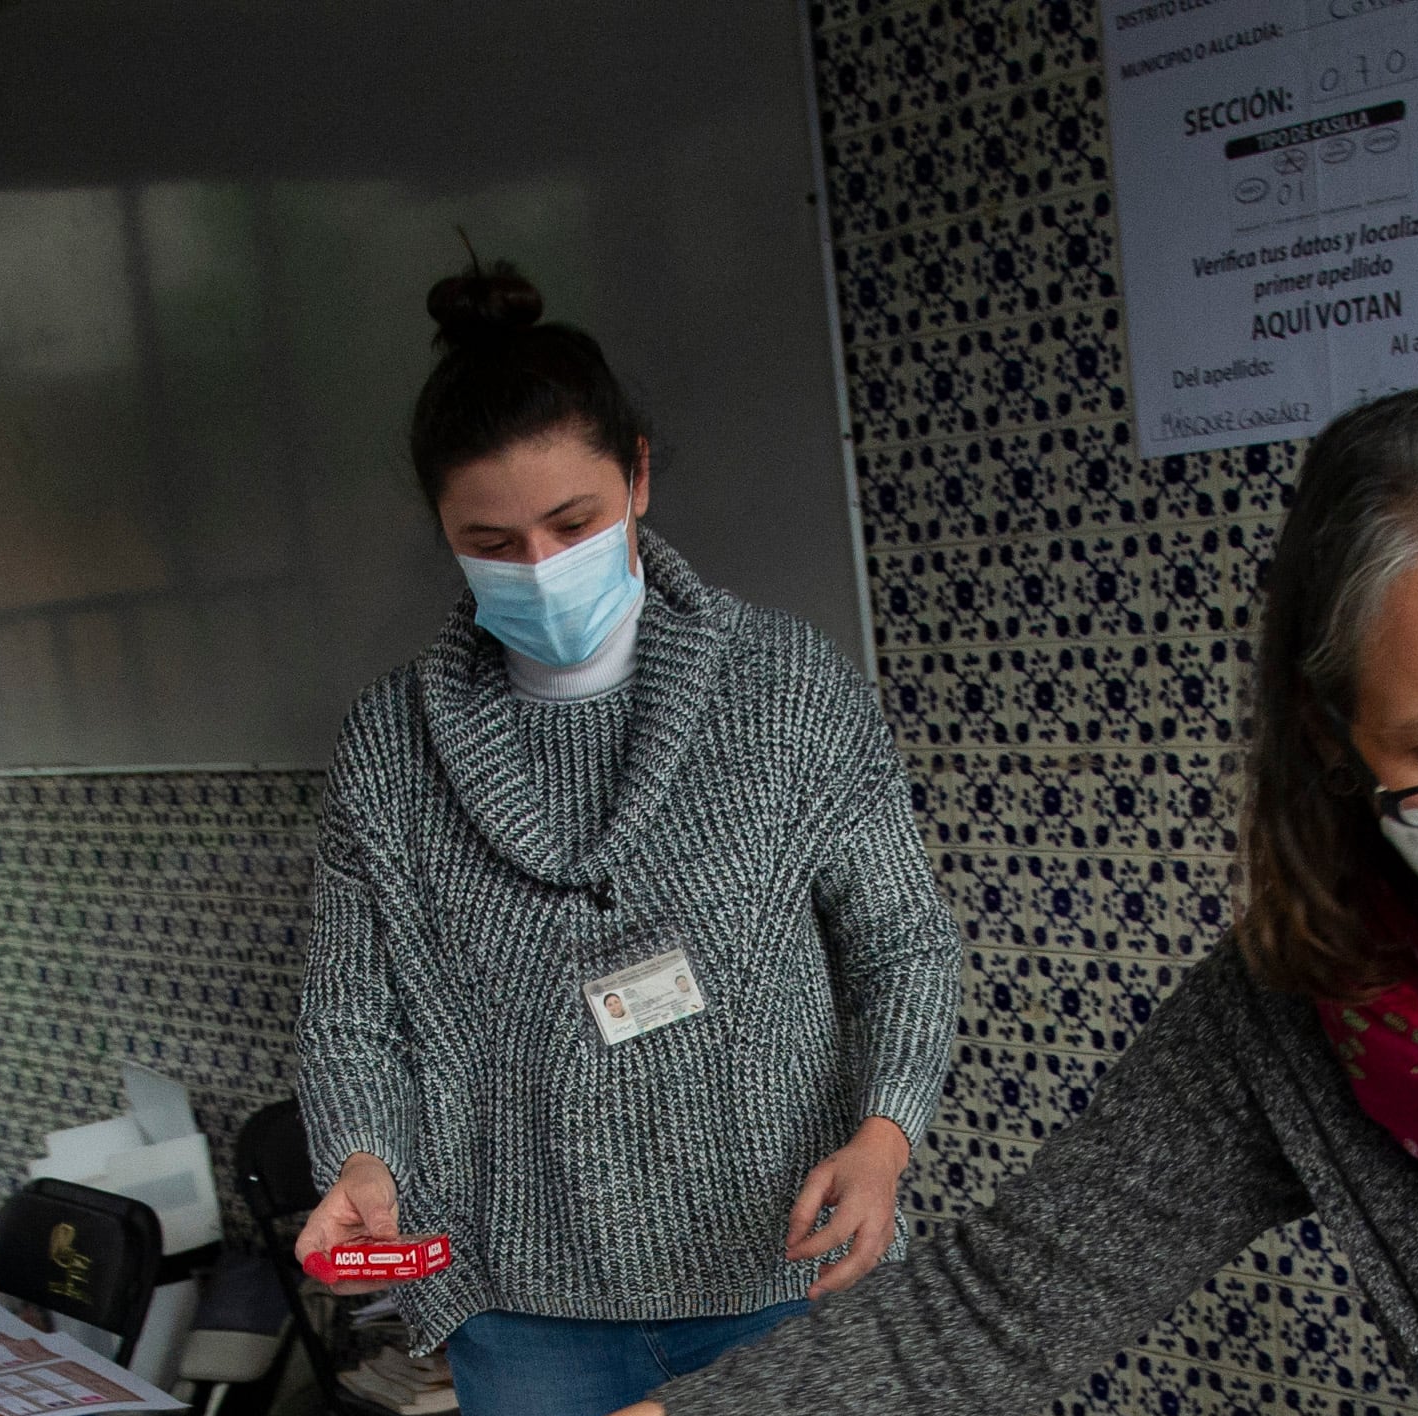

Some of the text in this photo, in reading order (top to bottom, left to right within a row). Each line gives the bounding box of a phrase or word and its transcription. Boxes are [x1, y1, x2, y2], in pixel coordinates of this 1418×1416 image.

[1120, 44, 1192, 80] MUNICIPIO
[1194, 42, 1207, 61] O
[1182, 79, 1294, 136] SECCIÓN:
[1290, 124, 1308, 143] DE
[1193, 244, 1261, 279] Verifica
[1263, 241, 1288, 264] tus
[1289, 229, 1341, 259] datos
[1343, 231, 1354, 252] y
[1253, 253, 1393, 303] primer apellido
[1250, 289, 1402, 342] AQUÍ VOTAN
[1390, 333, 1410, 355] Al
[1172, 355, 1274, 388] Del apellido:
[335, 1252, 364, 1266] ACCO
